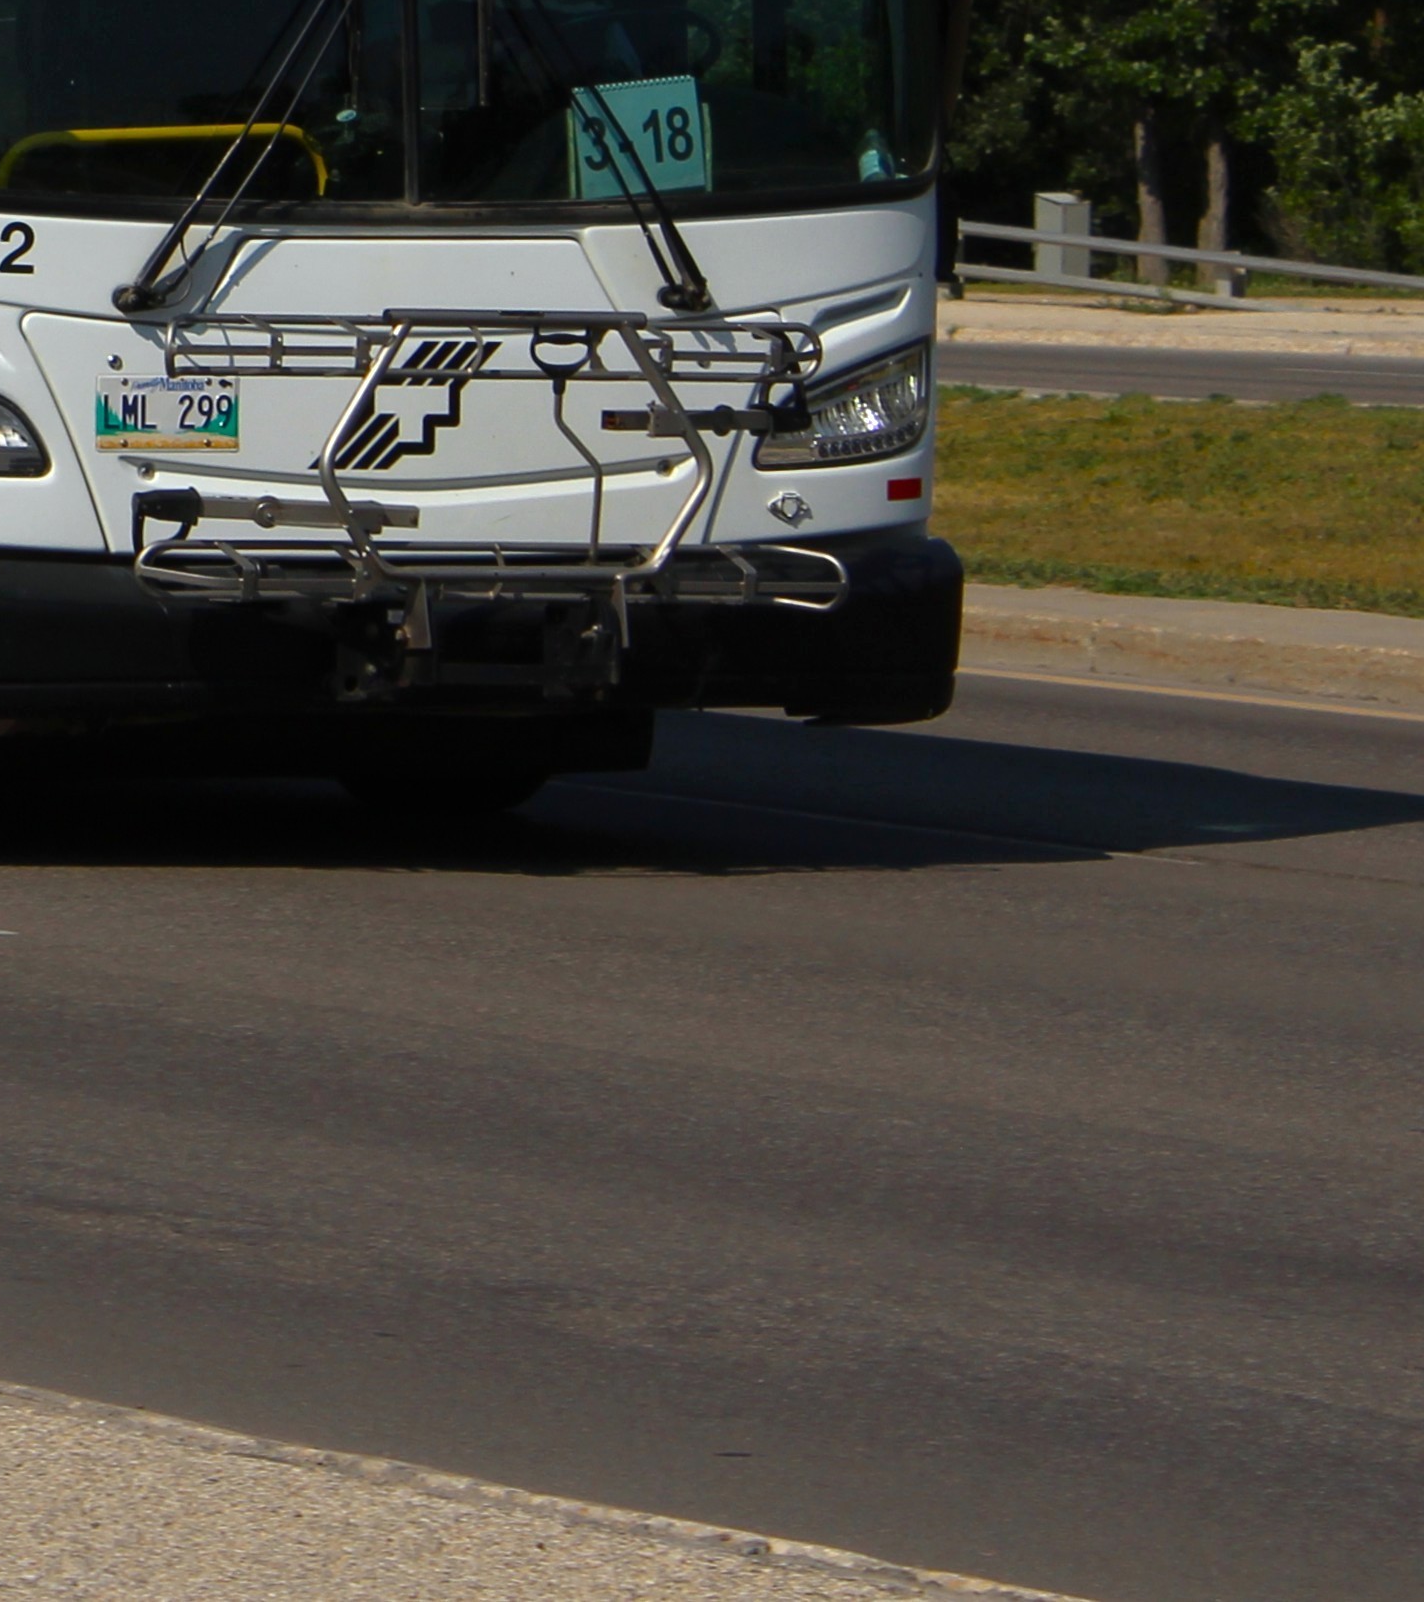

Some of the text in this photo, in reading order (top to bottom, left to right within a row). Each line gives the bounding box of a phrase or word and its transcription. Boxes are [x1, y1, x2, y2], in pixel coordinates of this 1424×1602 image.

[158, 377, 206, 392] Manitoba
[103, 394, 233, 430] LML 299
